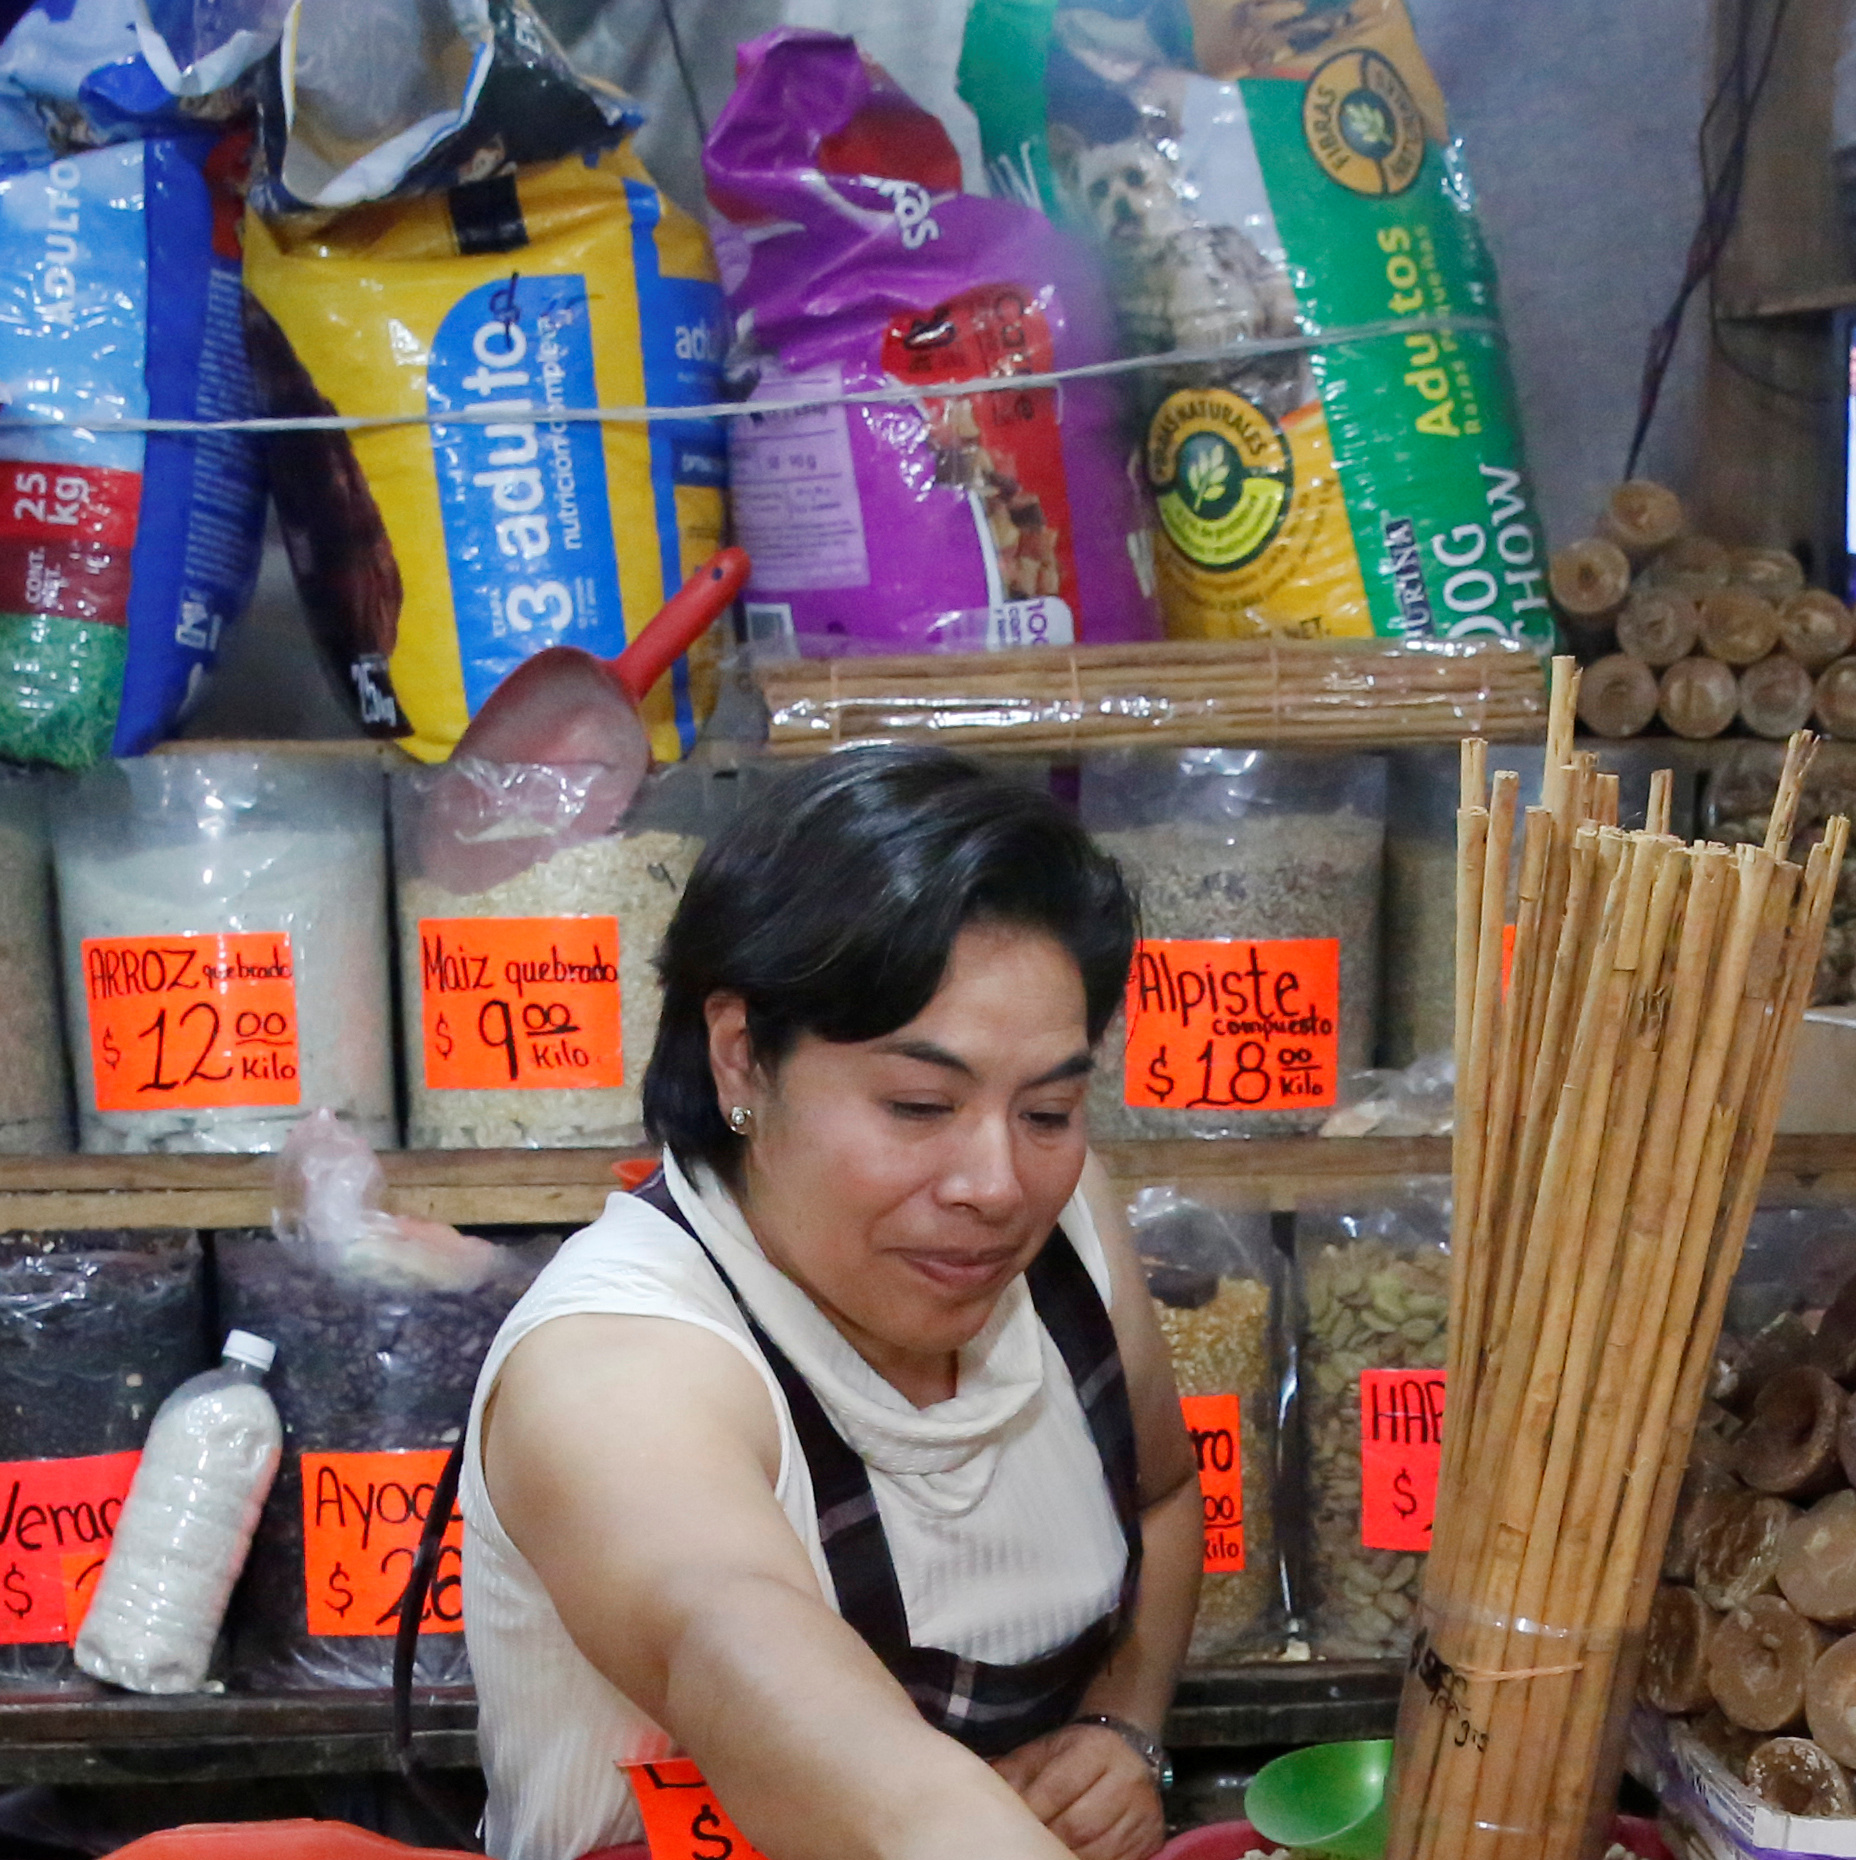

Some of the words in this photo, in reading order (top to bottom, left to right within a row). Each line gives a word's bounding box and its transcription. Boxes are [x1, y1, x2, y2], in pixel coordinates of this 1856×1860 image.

[37, 160, 80, 324] ADULTO
[1377, 225, 1459, 437] Adutos
[462, 320, 551, 559] adulto
[15, 472, 48, 521] 25
[48, 477, 90, 526] kg
[505, 582, 572, 633] 3
[90, 947, 197, 1000] ARROZ
[422, 934, 490, 993] Maiz
[505, 948, 619, 1001] quebrado
[1139, 950, 1300, 1029] Alpiste
[101, 1027, 123, 1069] $
[138, 1002, 234, 1094] 12
[235, 1010, 287, 1041] 00
[242, 1054, 297, 1084] Kilo
[435, 1012, 454, 1058] $
[477, 997, 520, 1083] 9
[534, 1041, 591, 1071] Kilo
[1146, 1047, 1175, 1103] $
[1185, 1041, 1271, 1108] 18
[1280, 1072, 1323, 1098] Kilo
